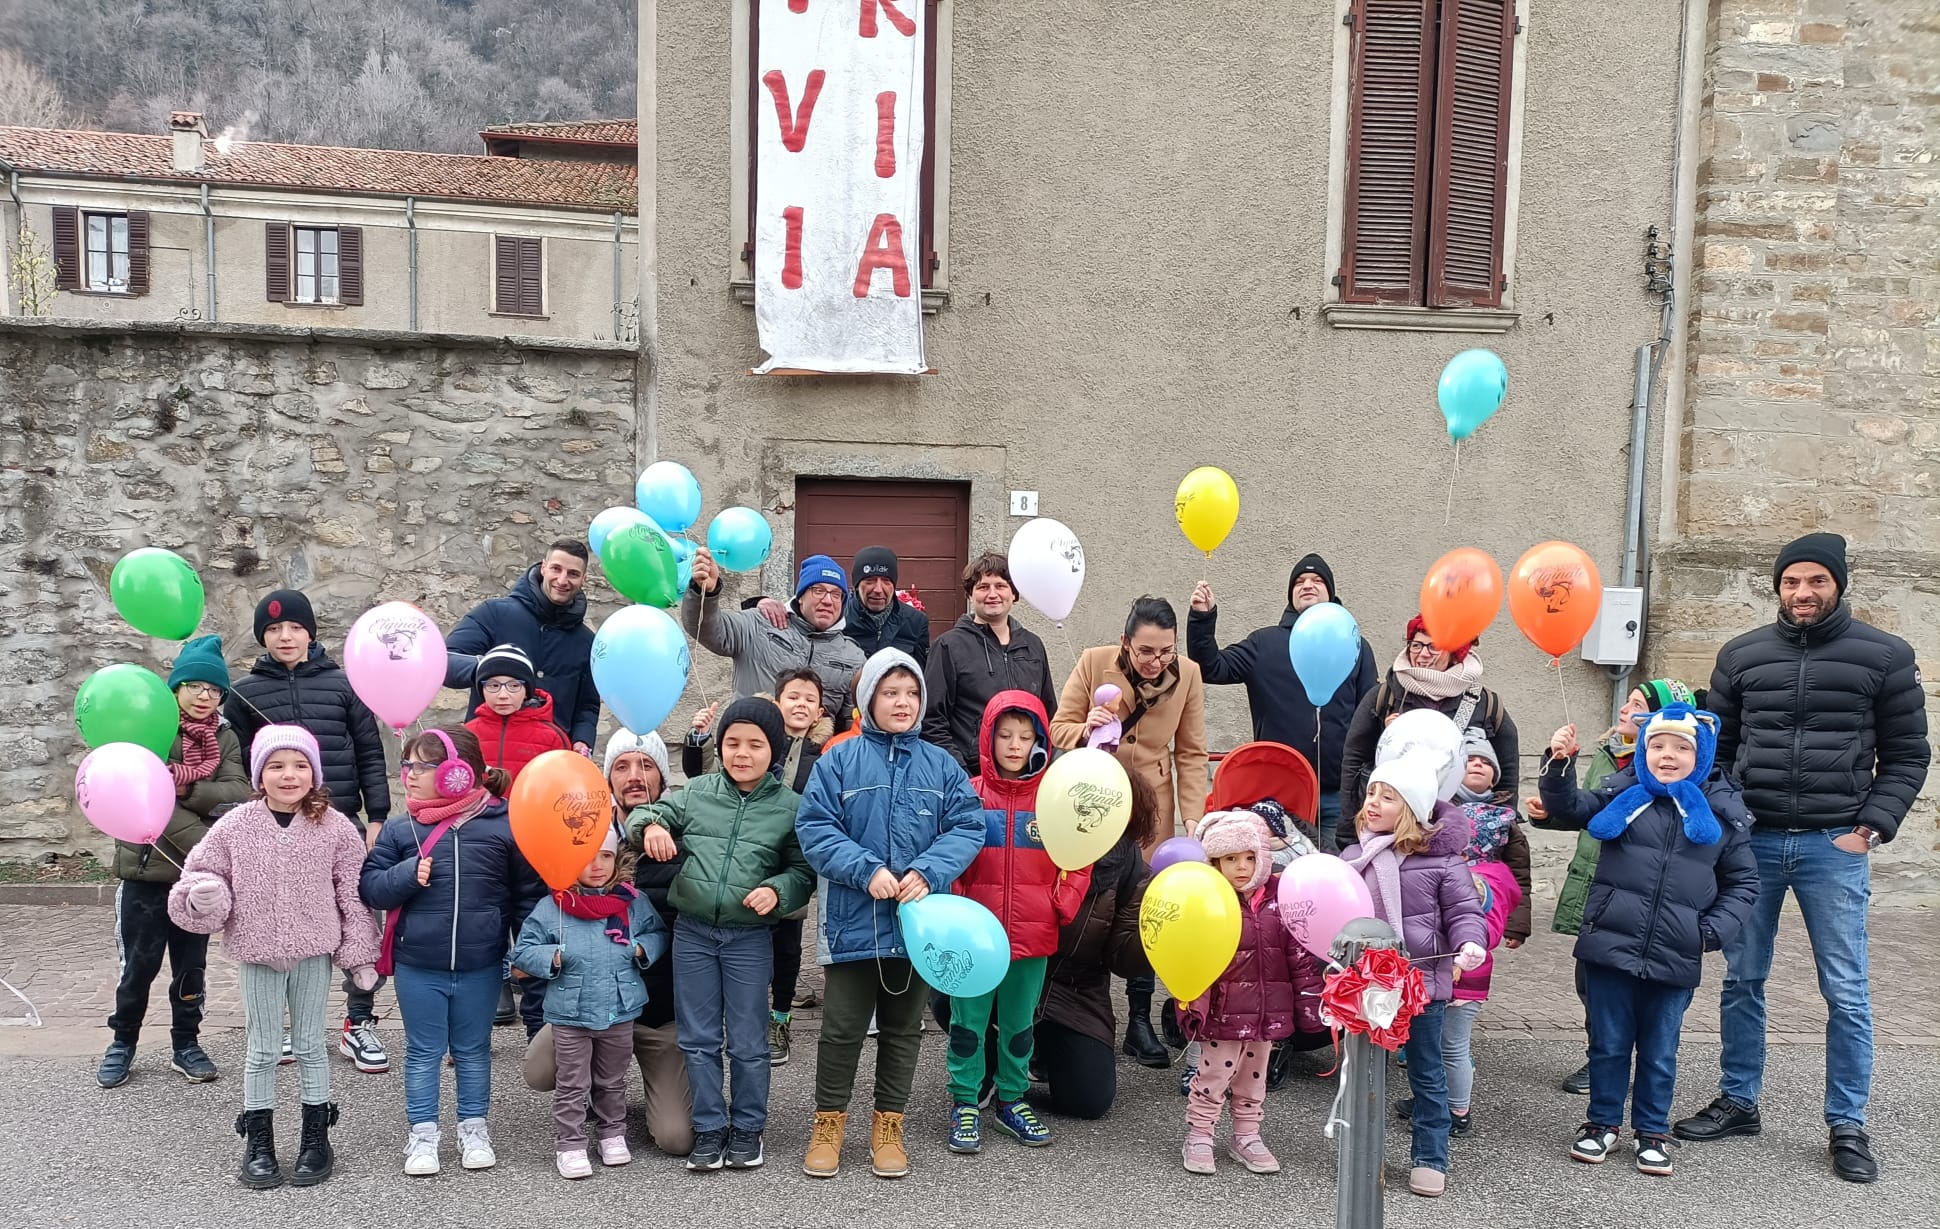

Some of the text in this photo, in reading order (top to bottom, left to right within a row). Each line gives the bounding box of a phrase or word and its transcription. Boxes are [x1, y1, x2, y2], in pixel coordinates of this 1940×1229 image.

[1020, 496, 1028, 510] 8
[562, 791, 612, 802] PRO-LOCO
[1068, 783, 1123, 808] Olginate
[1078, 782, 1123, 799] PRO-LOCO
[553, 797, 613, 817] Olginate
